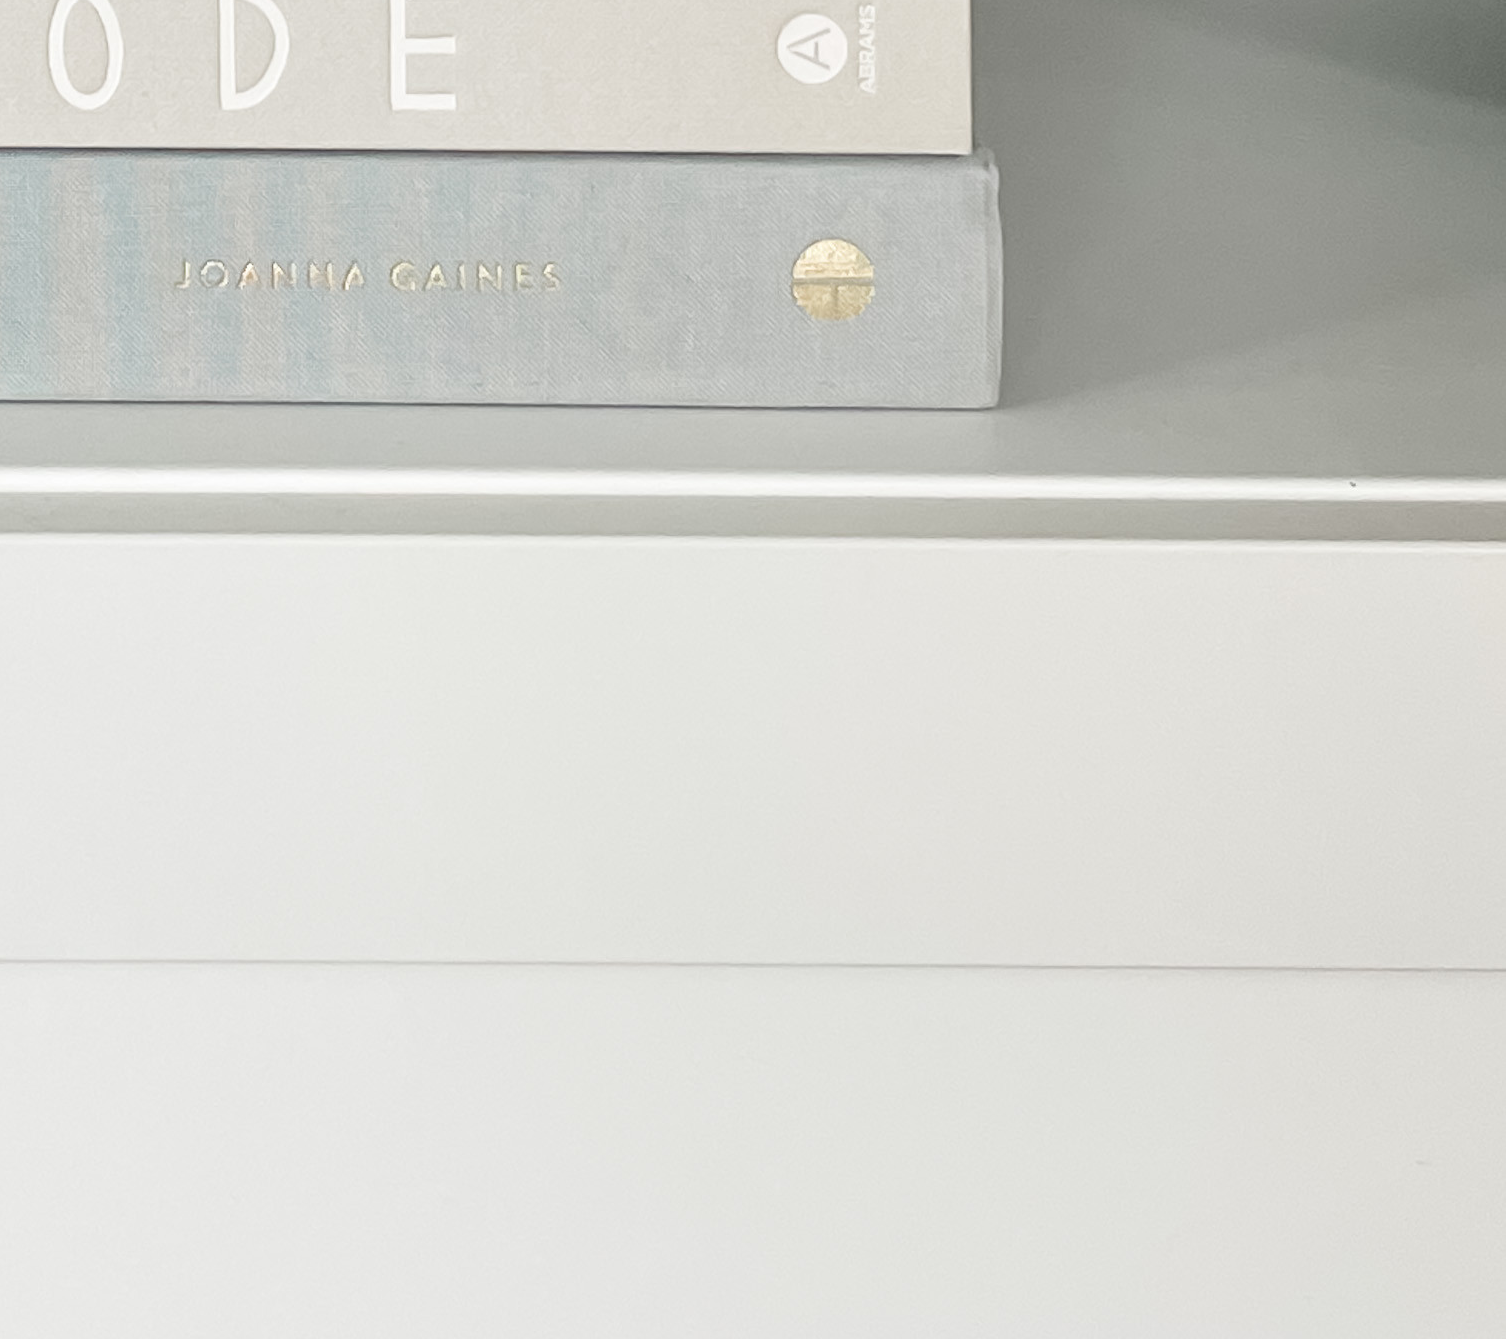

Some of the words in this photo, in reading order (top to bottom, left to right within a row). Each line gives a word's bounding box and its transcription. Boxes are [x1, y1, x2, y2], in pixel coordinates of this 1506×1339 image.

[858, 3, 877, 96] ABRAMS
[174, 258, 367, 291] JOANNA
[388, 260, 562, 292] GAINES
